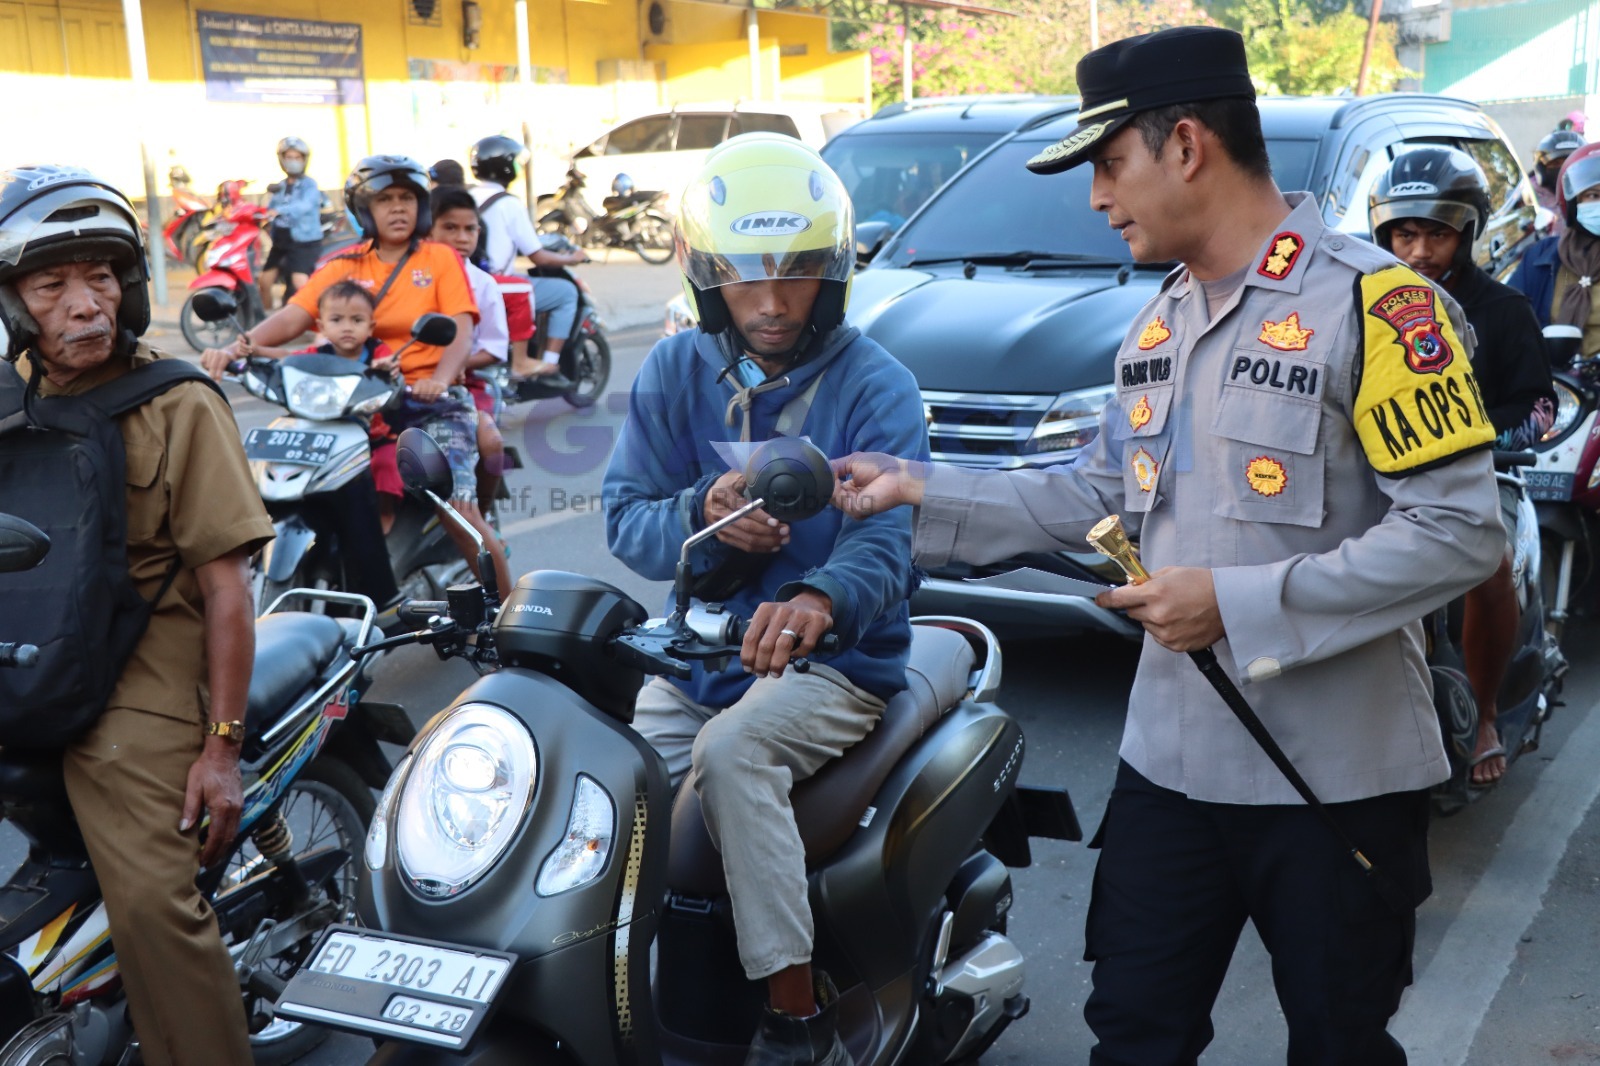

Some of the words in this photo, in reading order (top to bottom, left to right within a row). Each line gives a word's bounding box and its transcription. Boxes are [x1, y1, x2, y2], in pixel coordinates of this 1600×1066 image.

[740, 216, 802, 230] INK
[1381, 290, 1426, 312] POLRES
[1231, 355, 1318, 396] POLRI
[1370, 397, 1422, 460] KA
[1415, 376, 1472, 439] OPS
[248, 430, 259, 444] L
[267, 431, 306, 446] 2012
[311, 434, 335, 448] DR
[510, 603, 553, 616] HONDA
[313, 941, 357, 974] ED
[364, 949, 442, 989] 2303
[450, 965, 497, 1000] AI
